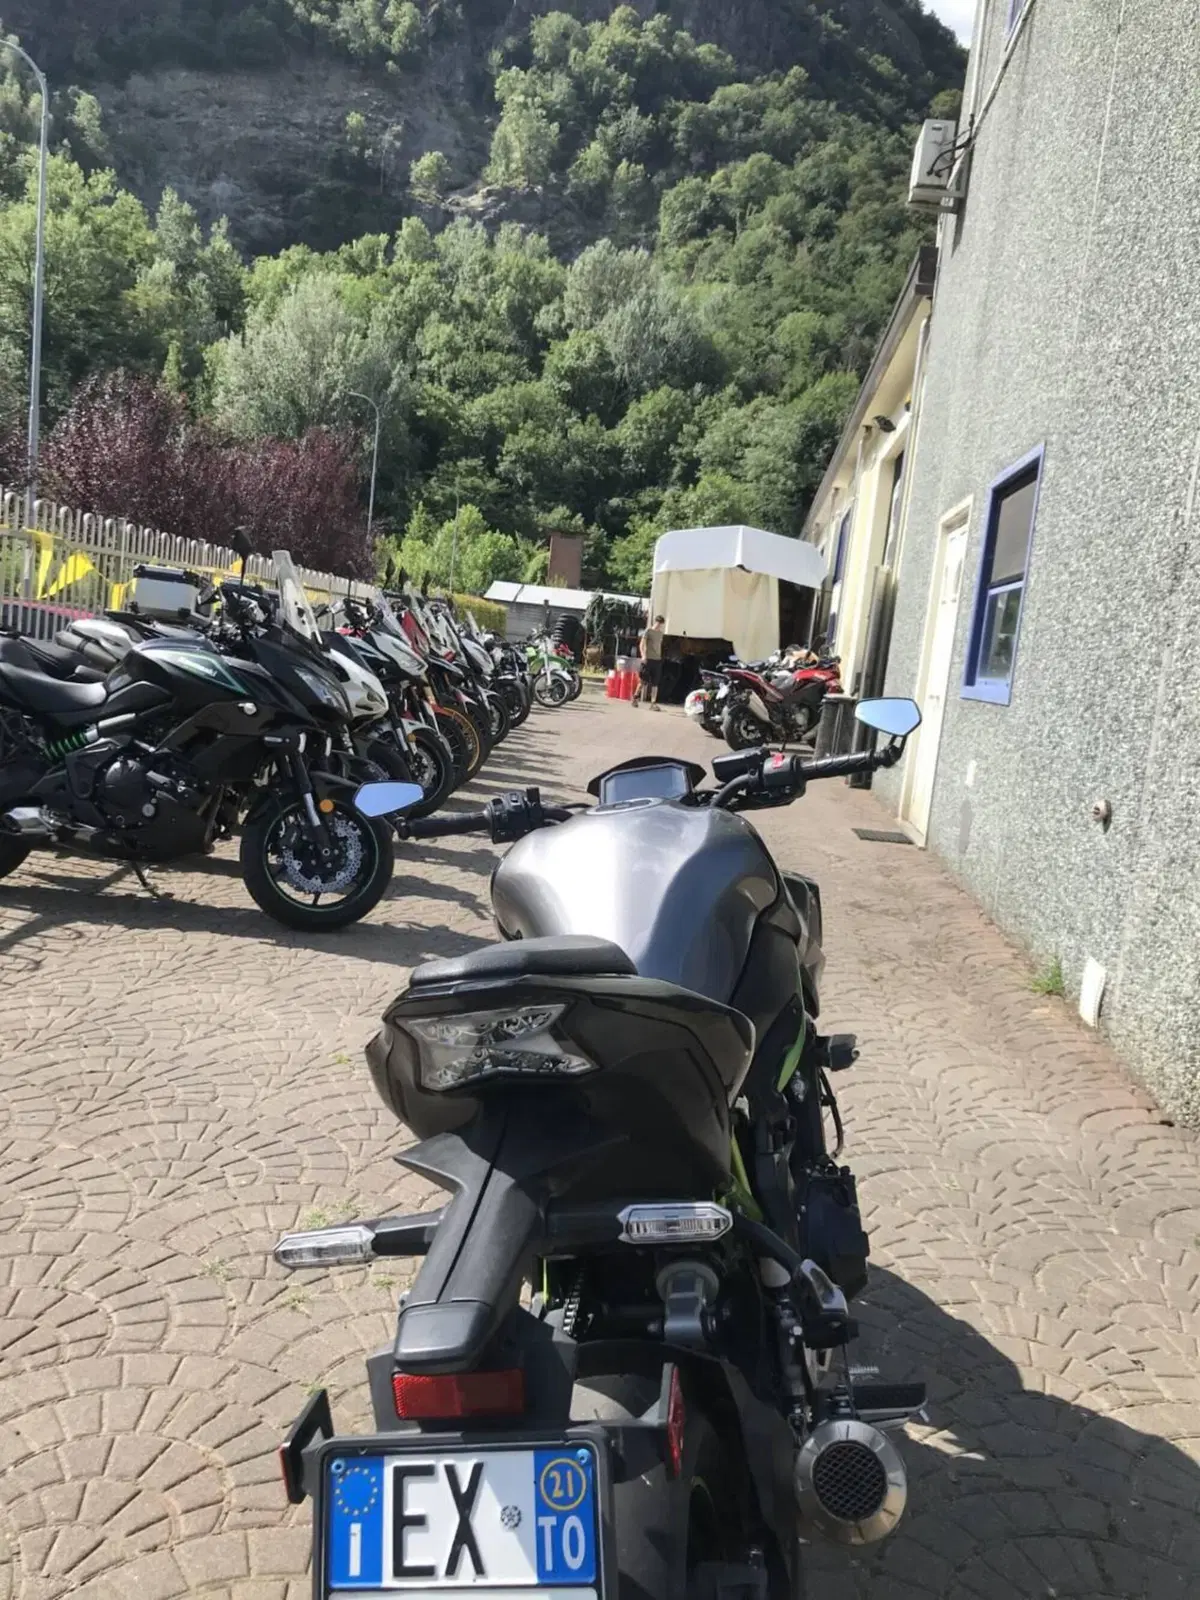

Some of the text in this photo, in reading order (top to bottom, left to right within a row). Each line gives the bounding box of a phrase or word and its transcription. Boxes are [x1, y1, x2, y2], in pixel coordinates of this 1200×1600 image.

[550, 1470, 574, 1498] 21
[393, 1462, 484, 1577] EX
[538, 1515, 585, 1571] TO
[349, 1523, 362, 1576] I
